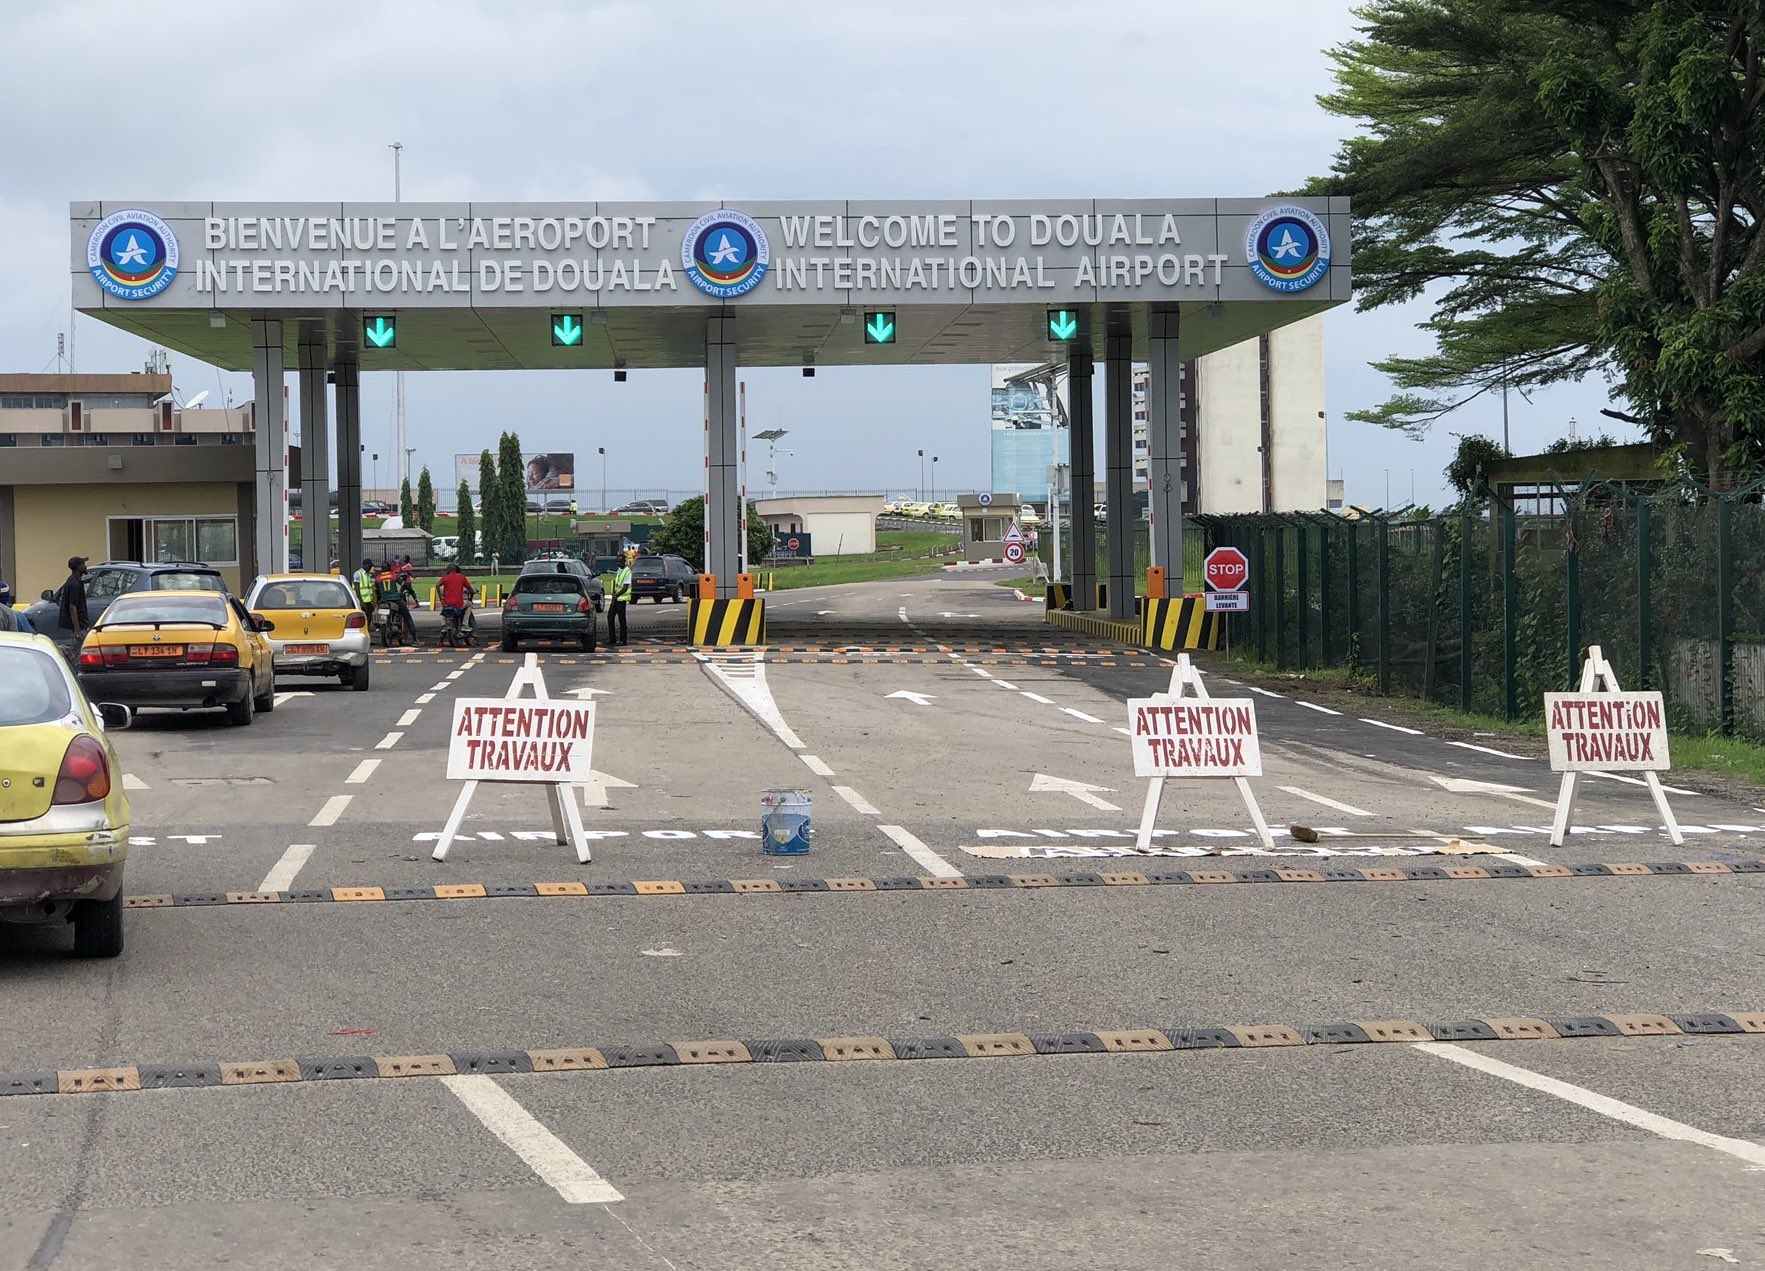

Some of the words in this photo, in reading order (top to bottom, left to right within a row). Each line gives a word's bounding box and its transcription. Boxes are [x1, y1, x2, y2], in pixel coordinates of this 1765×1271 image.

[91, 223, 108, 262] CAMEROON
[108, 215, 125, 226] CIVIL
[126, 213, 158, 227] AVIATION
[158, 225, 176, 263] AUTHORITY
[205, 217, 396, 250] BIENVENUE
[406, 217, 429, 249] A
[683, 225, 701, 263] CAMEROON
[699, 215, 715, 226] CIVIL
[717, 212, 749, 225] AVIATION
[748, 222, 767, 260] AUTHORITY
[779, 215, 958, 248] WELCOME
[971, 215, 1016, 247] TO
[1030, 213, 1182, 246] DOUALA
[1248, 219, 1264, 258] CAMEROON
[1263, 210, 1279, 222] CIVIL
[1280, 207, 1310, 221] AVIATION
[1309, 218, 1328, 253] AUTHORITY
[93, 268, 130, 297] AIRPORT
[132, 269, 173, 297] SECURITY
[196, 259, 471, 292] INTERNATIONAL
[479, 259, 524, 292] DE
[532, 258, 678, 291] DOUALA
[688, 269, 726, 296] AIRPORT
[726, 265, 765, 296] SECURITY
[775, 255, 1056, 289] INTERNATIONAL
[1074, 253, 1229, 288] AIRPORT
[1251, 264, 1289, 290] AIRPORT
[1289, 259, 1326, 290] SECURITY
[1010, 548, 1019, 557] 20
[1209, 564, 1244, 575] STOP
[457, 706, 589, 739] ATTENTION
[1136, 706, 1252, 735] ATTENTION
[1551, 701, 1660, 730] ATTENTION
[467, 739, 573, 772] TRAVAUX
[1147, 738, 1246, 767] TRAVAUX
[1562, 732, 1654, 761] TRAVAUX
[412, 830, 816, 841] AIRPOR
